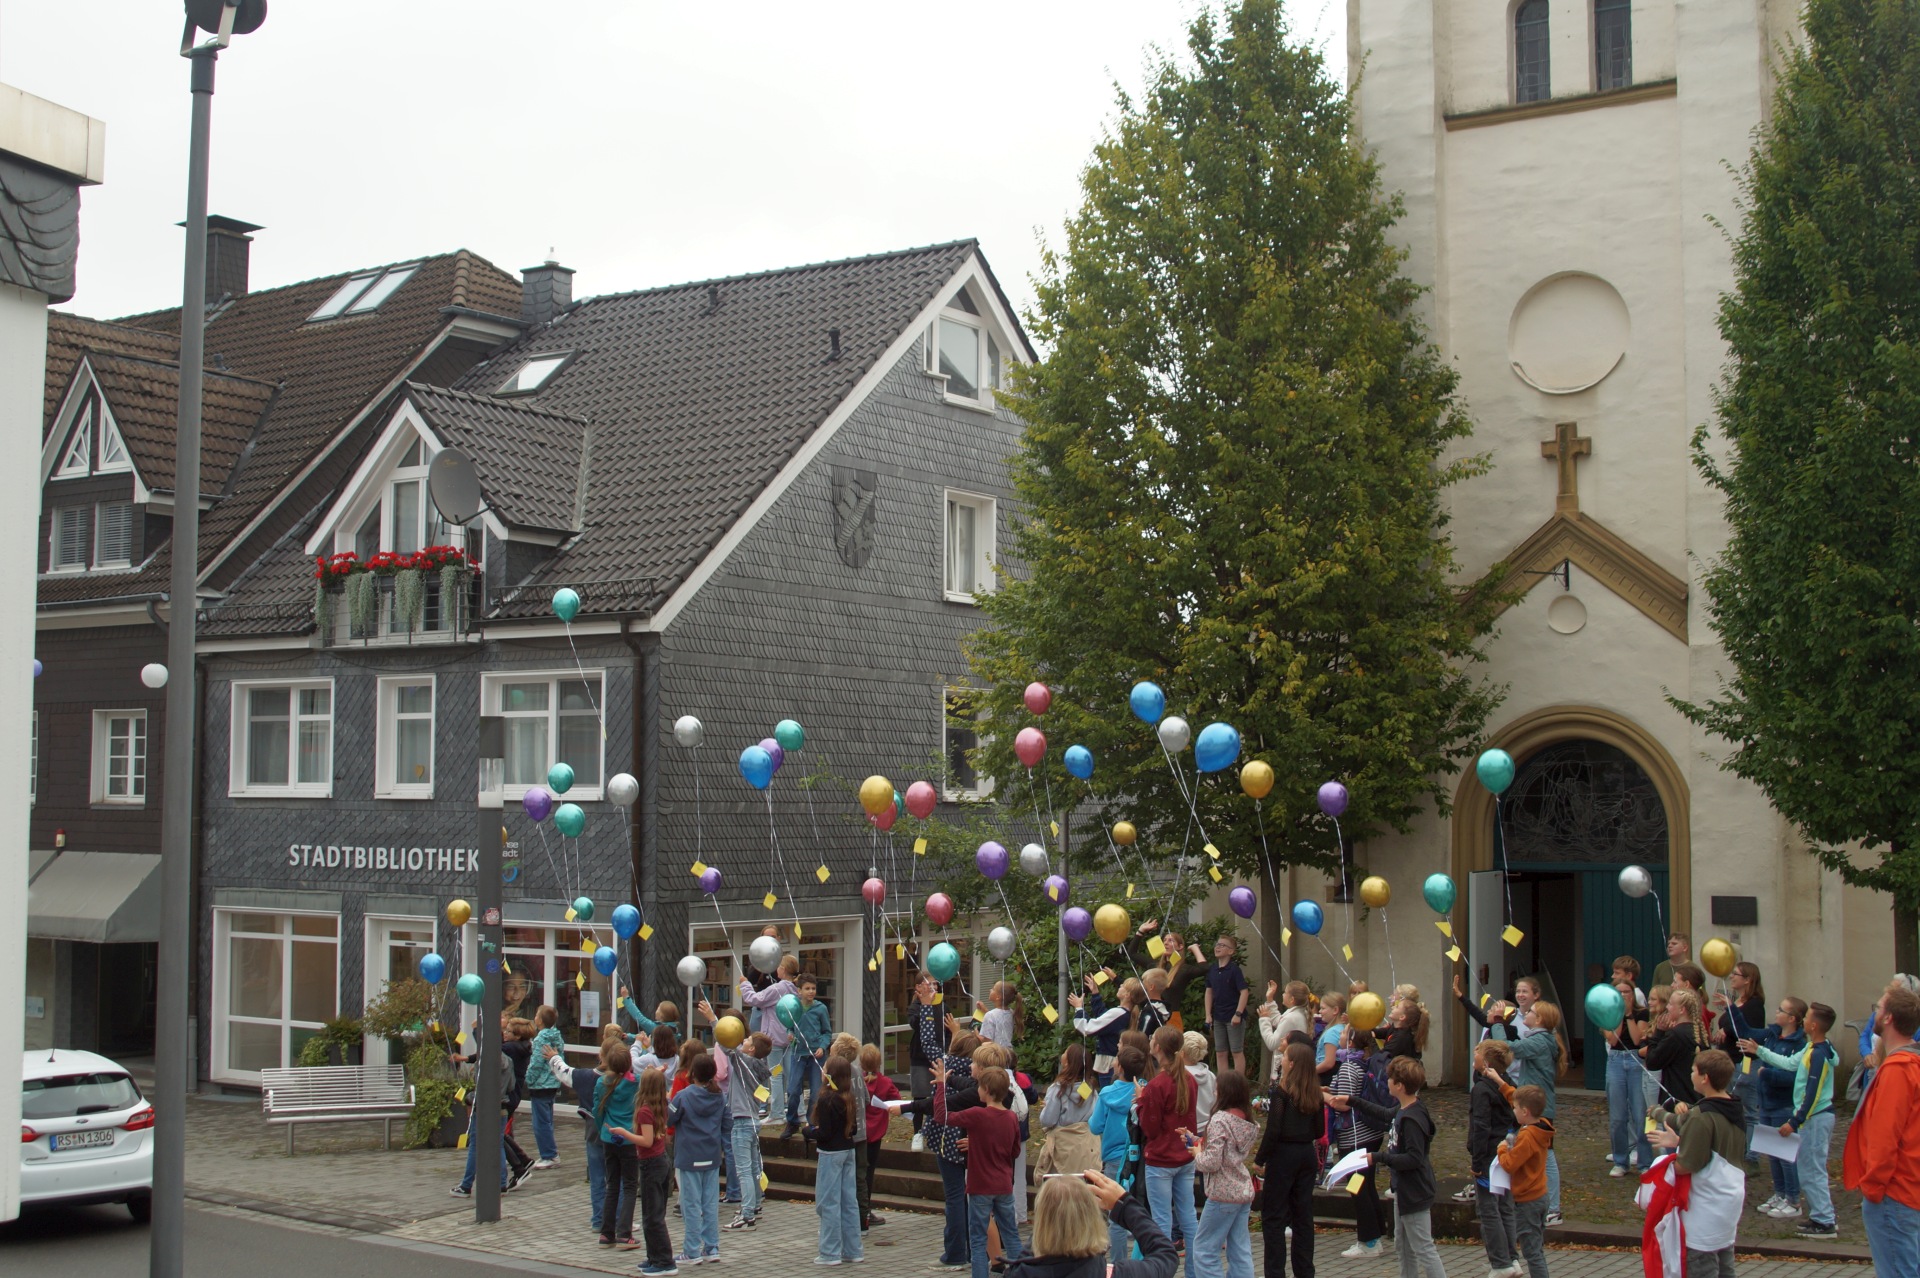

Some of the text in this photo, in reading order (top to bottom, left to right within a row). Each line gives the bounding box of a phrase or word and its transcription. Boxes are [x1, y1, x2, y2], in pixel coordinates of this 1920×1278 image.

[289, 844, 479, 872] STADTBIBLIOTHEK
[502, 849, 519, 858] adt
[57, 1131, 112, 1145] RS N 1306
